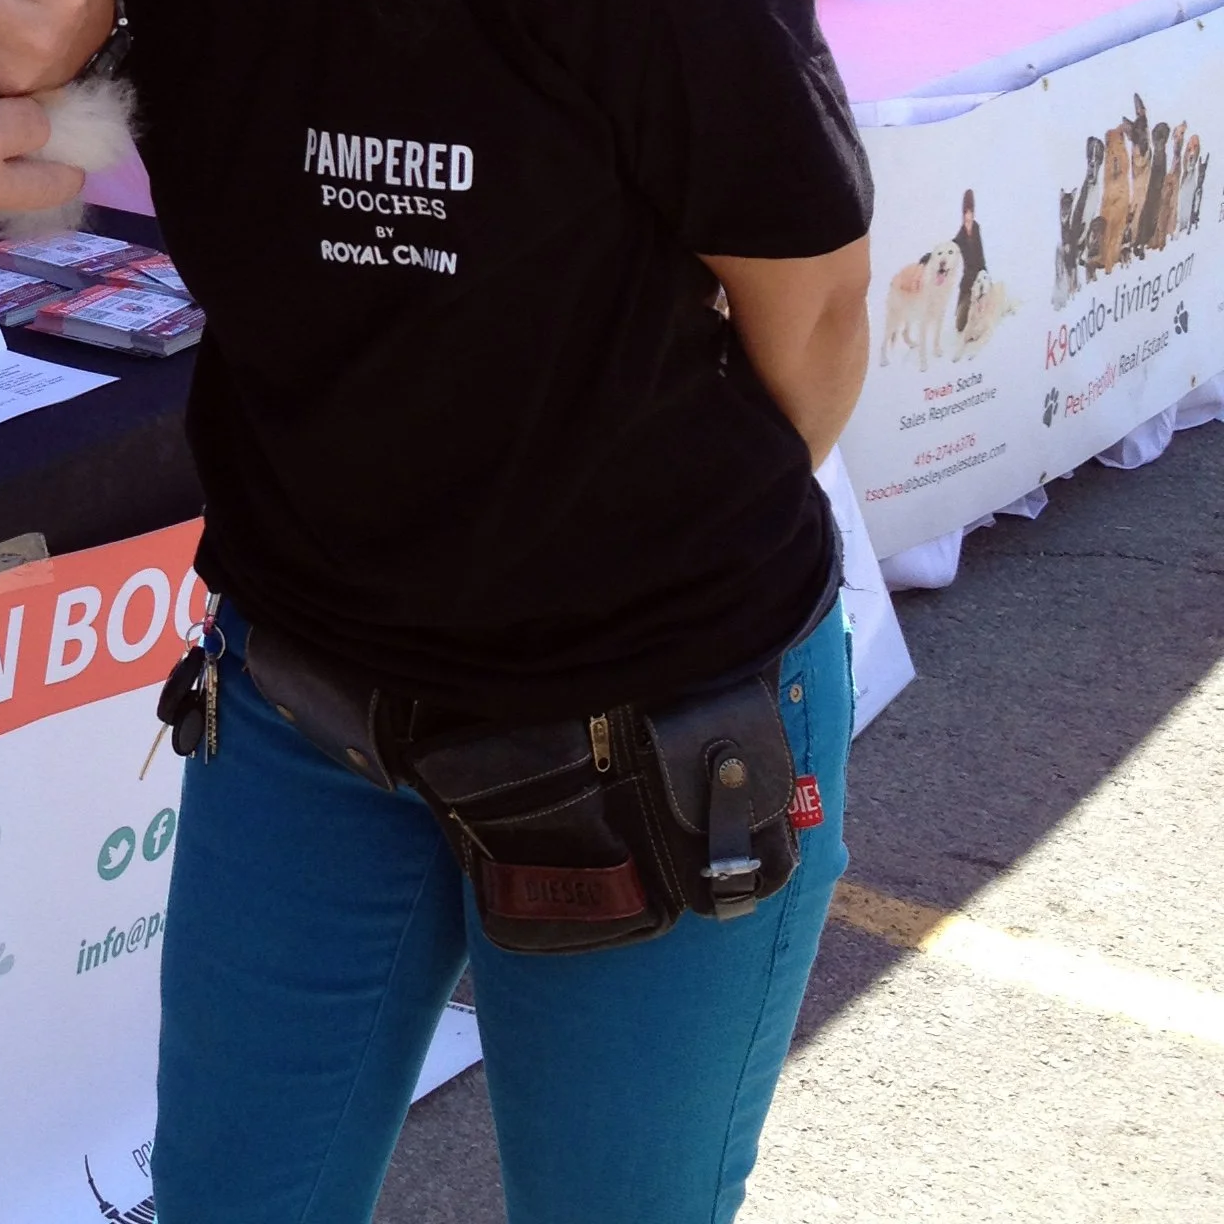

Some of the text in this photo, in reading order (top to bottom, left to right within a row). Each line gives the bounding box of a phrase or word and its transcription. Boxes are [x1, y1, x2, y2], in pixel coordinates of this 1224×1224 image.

[304, 127, 474, 191] PAMPERED
[321, 184, 447, 220] POOCHES
[376, 226, 394, 238] BY
[321, 239, 458, 275] ROYAL CANIN
[1045, 252, 1195, 370] k9condo-living.com
[1119, 345, 1139, 376] Real
[1141, 330, 1169, 362] Estate
[899, 387, 997, 431] Sales Representative
[525, 880, 603, 907] DIESEL
